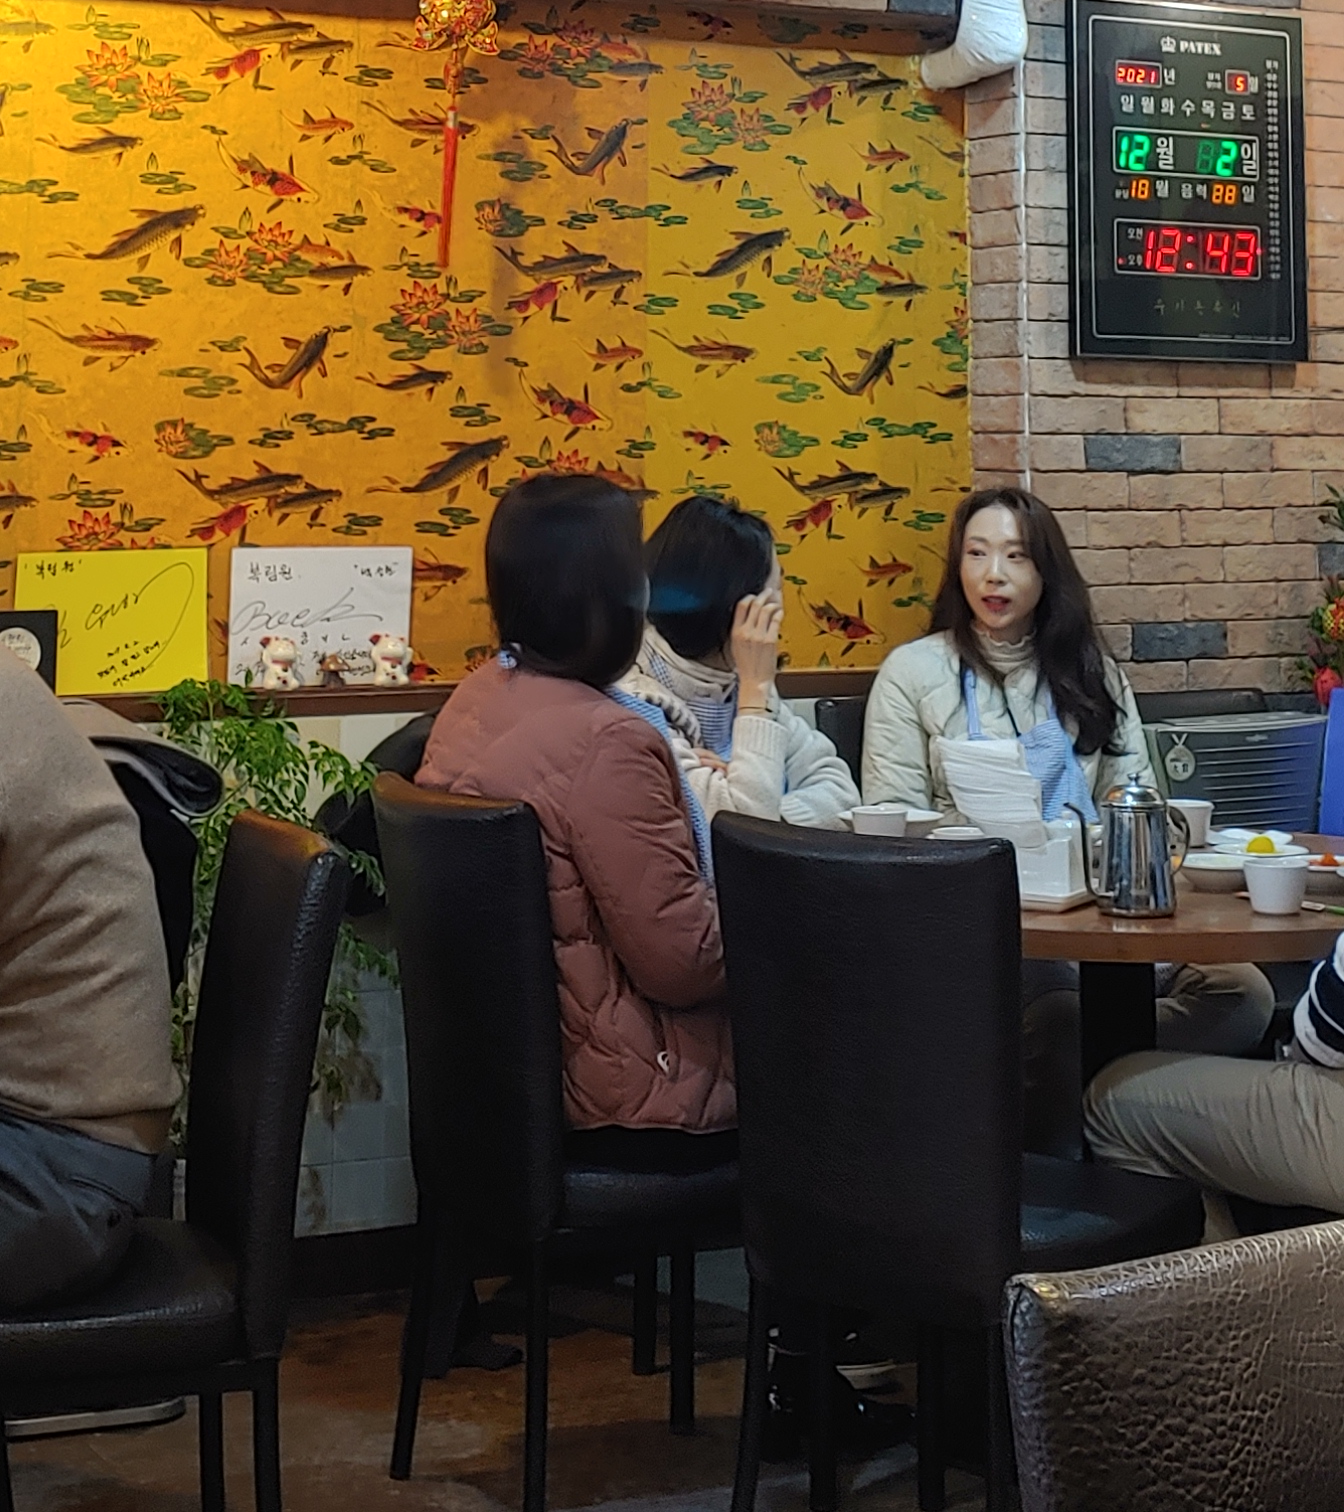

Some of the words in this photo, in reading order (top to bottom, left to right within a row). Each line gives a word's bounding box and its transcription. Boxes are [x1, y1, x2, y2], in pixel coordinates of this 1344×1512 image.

[1179, 40, 1222, 56] PATEX
[1117, 67, 1155, 83] 2021
[1164, 68, 1176, 86] 년
[1235, 77, 1245, 92] 5
[1120, 94, 1135, 113] 일
[1141, 96, 1155, 115] 월
[1161, 97, 1175, 117] 화
[1181, 99, 1196, 117] 수
[1201, 99, 1216, 119] 목
[1221, 101, 1236, 121] 금
[1241, 104, 1256, 121] 토
[1119, 135, 1151, 171] 12
[1156, 136, 1174, 170] 월
[1240, 142, 1257, 176] 일
[1242, 185, 1255, 203] 일
[1145, 228, 1256, 276] 12:43
